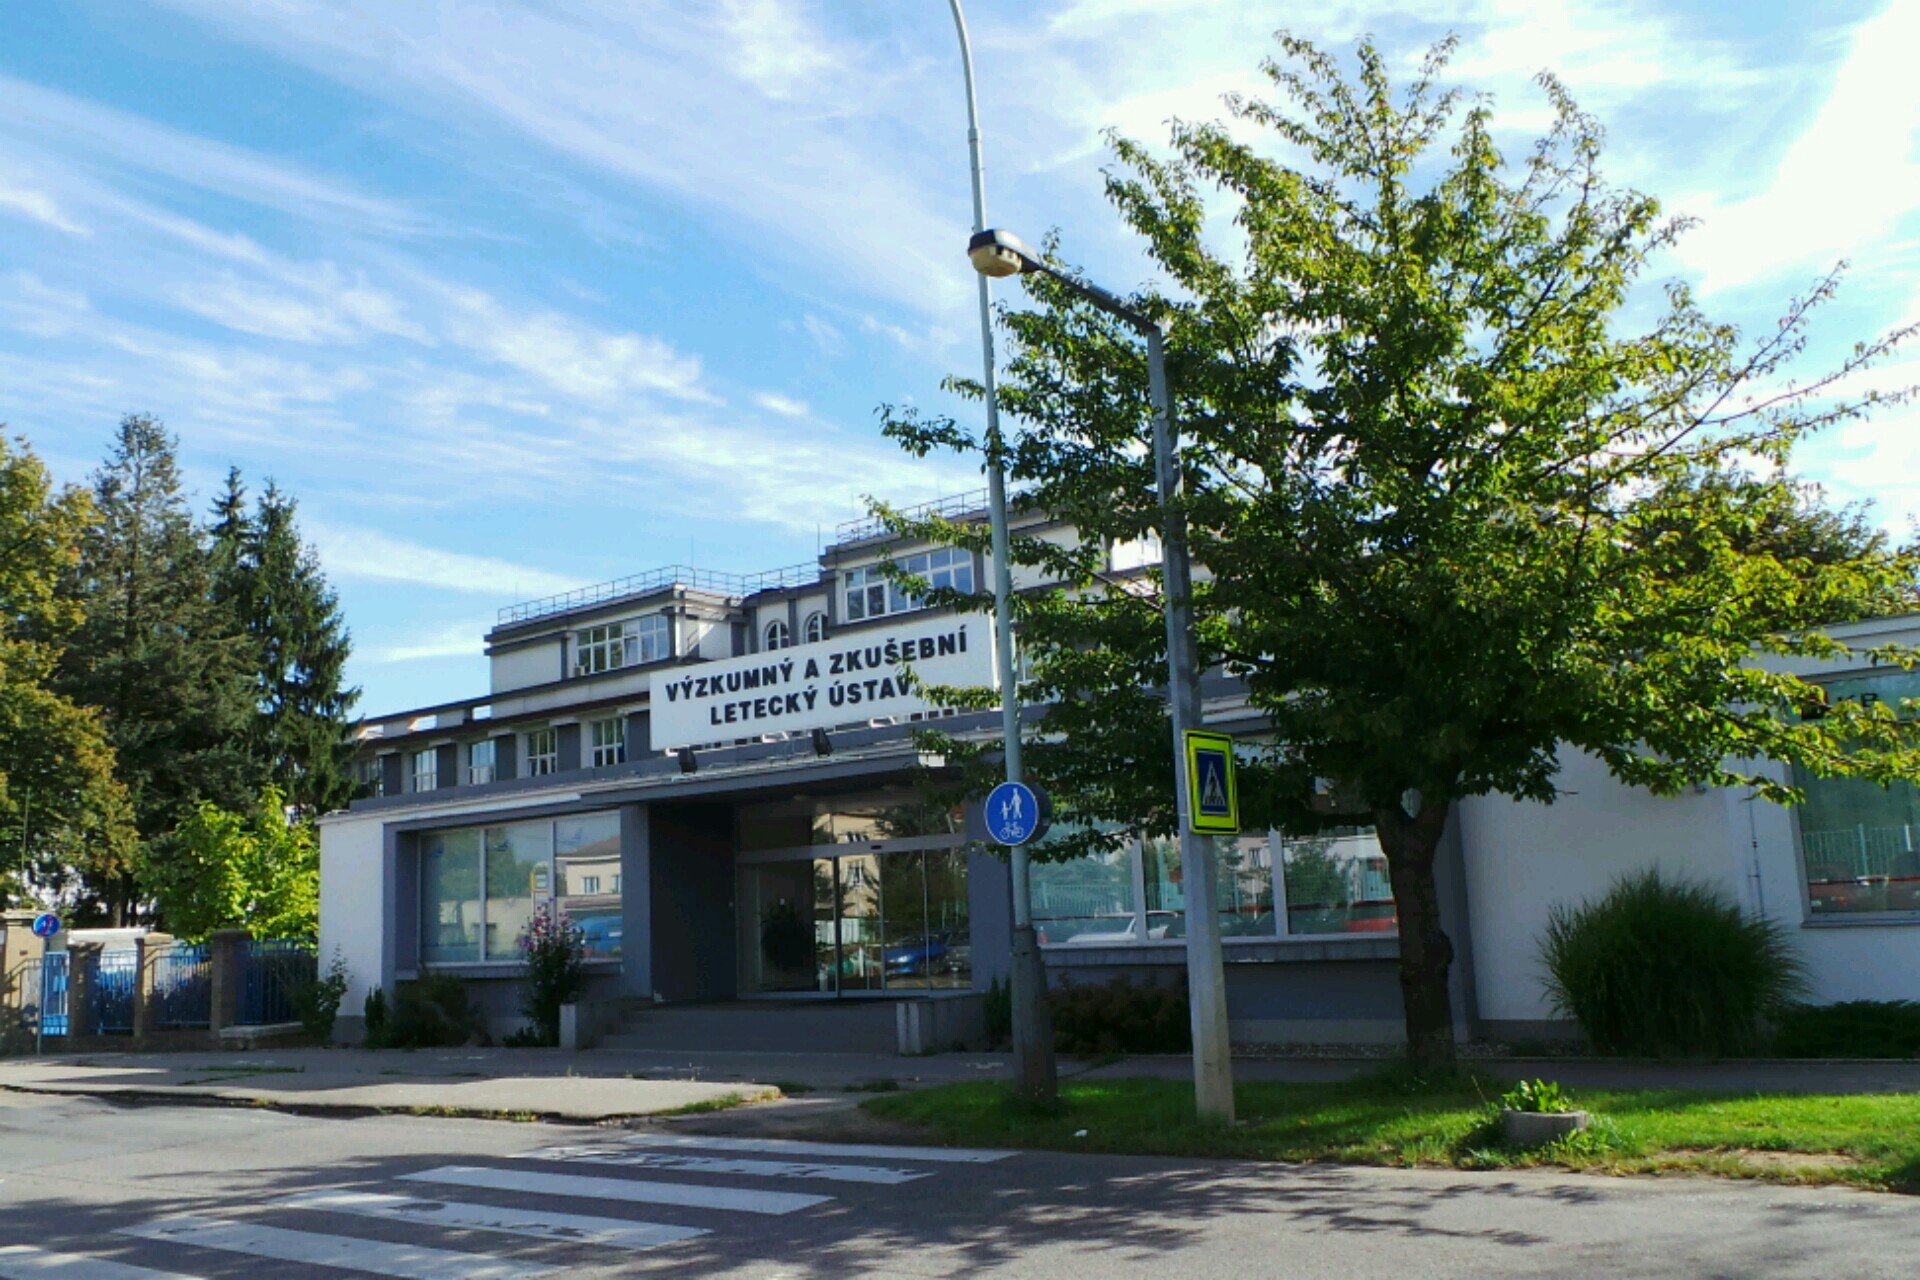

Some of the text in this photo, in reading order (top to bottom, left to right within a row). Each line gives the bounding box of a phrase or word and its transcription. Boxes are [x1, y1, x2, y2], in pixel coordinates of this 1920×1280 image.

[665, 624, 968, 703] VÝZKUMNÝ A ZKUŠEBNÍ
[710, 674, 913, 726] LETECKÝ ÚSTAV
